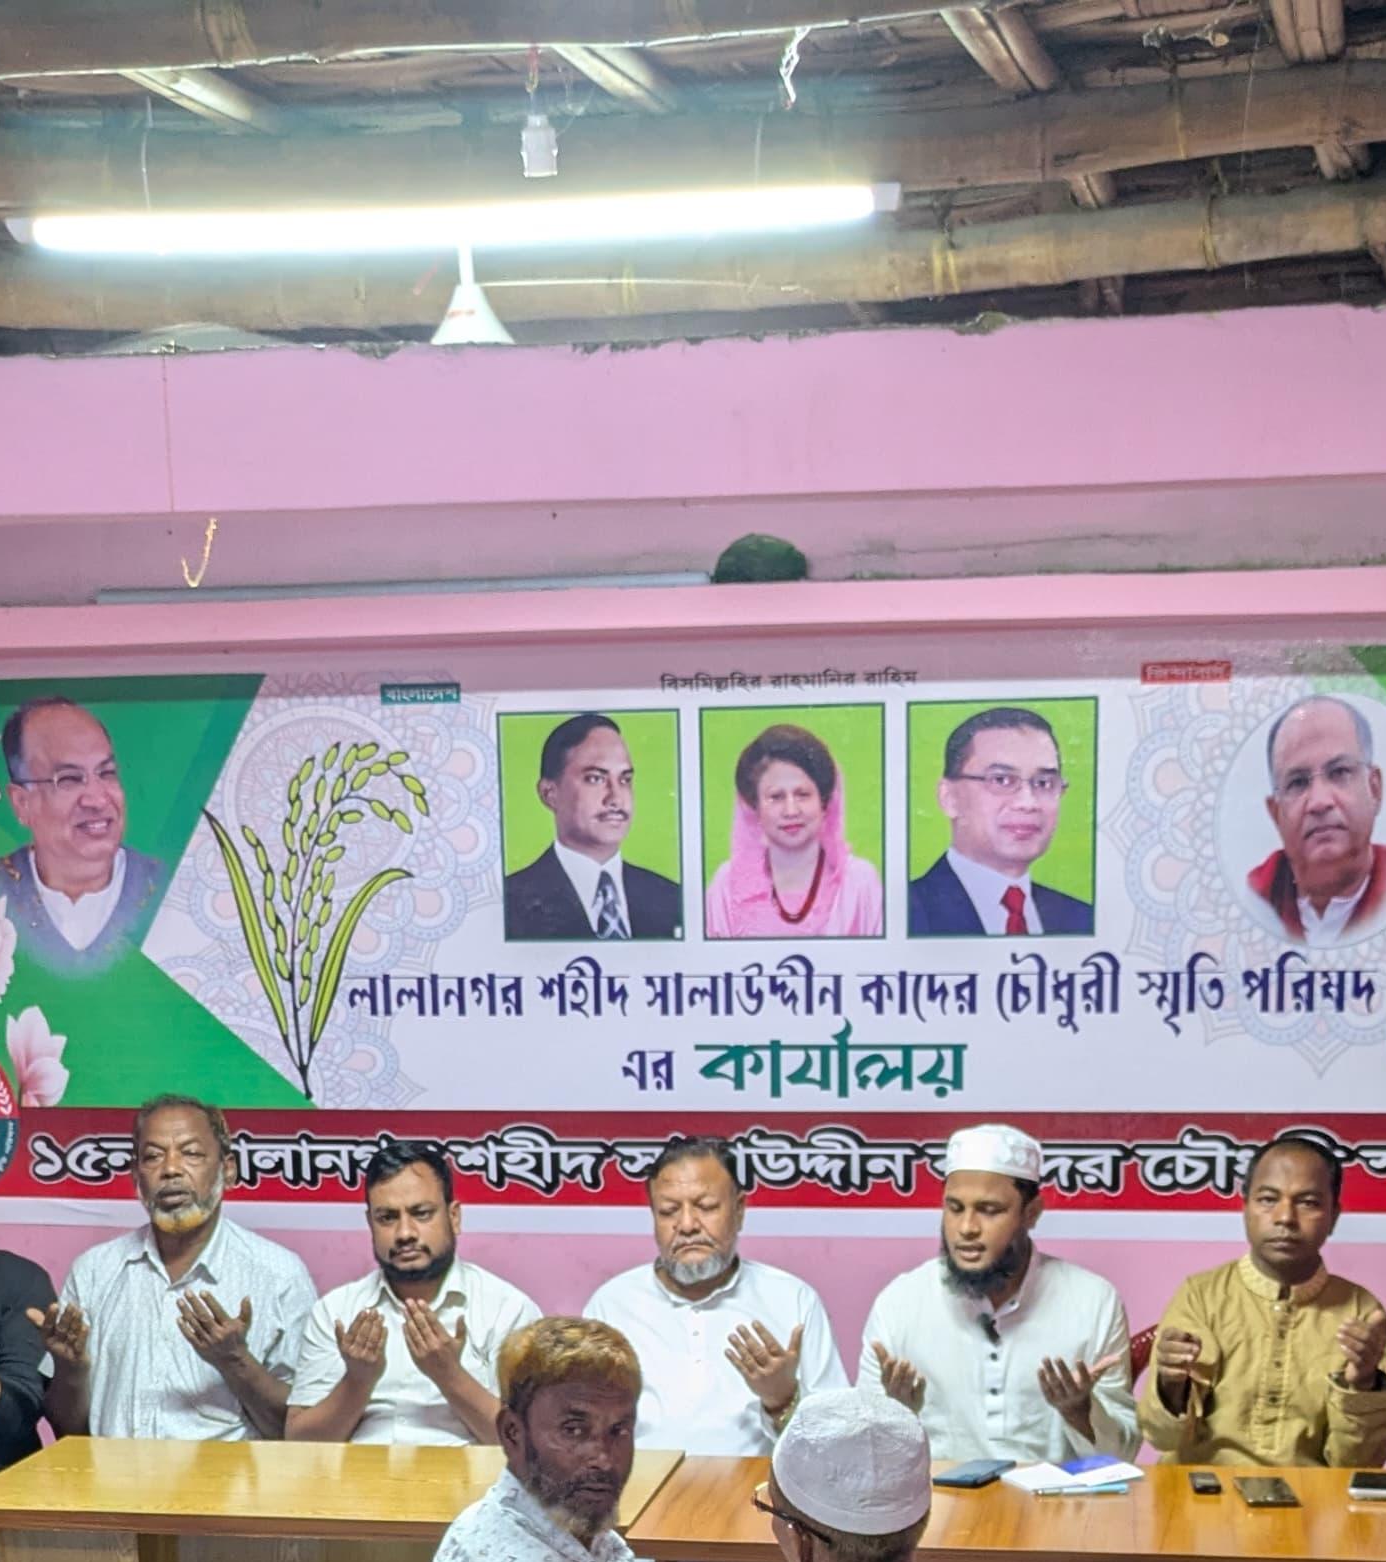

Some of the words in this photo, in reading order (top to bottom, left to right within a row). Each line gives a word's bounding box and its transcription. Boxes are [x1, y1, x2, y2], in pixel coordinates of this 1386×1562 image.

[346, 972, 524, 1017] লালানগর
[536, 955, 630, 1018] শহীদ
[642, 954, 844, 1017] সালাউদ্দীন
[857, 970, 979, 1024] কাদের
[996, 951, 1121, 1034] চৌধুরী
[1136, 951, 1226, 1036] স্মৃতি
[1242, 950, 1380, 1017] পরিষদ
[621, 1050, 675, 1092] এর
[694, 1017, 969, 1099] কার্যালয়
[451, 1123, 611, 1196] শহীদ
